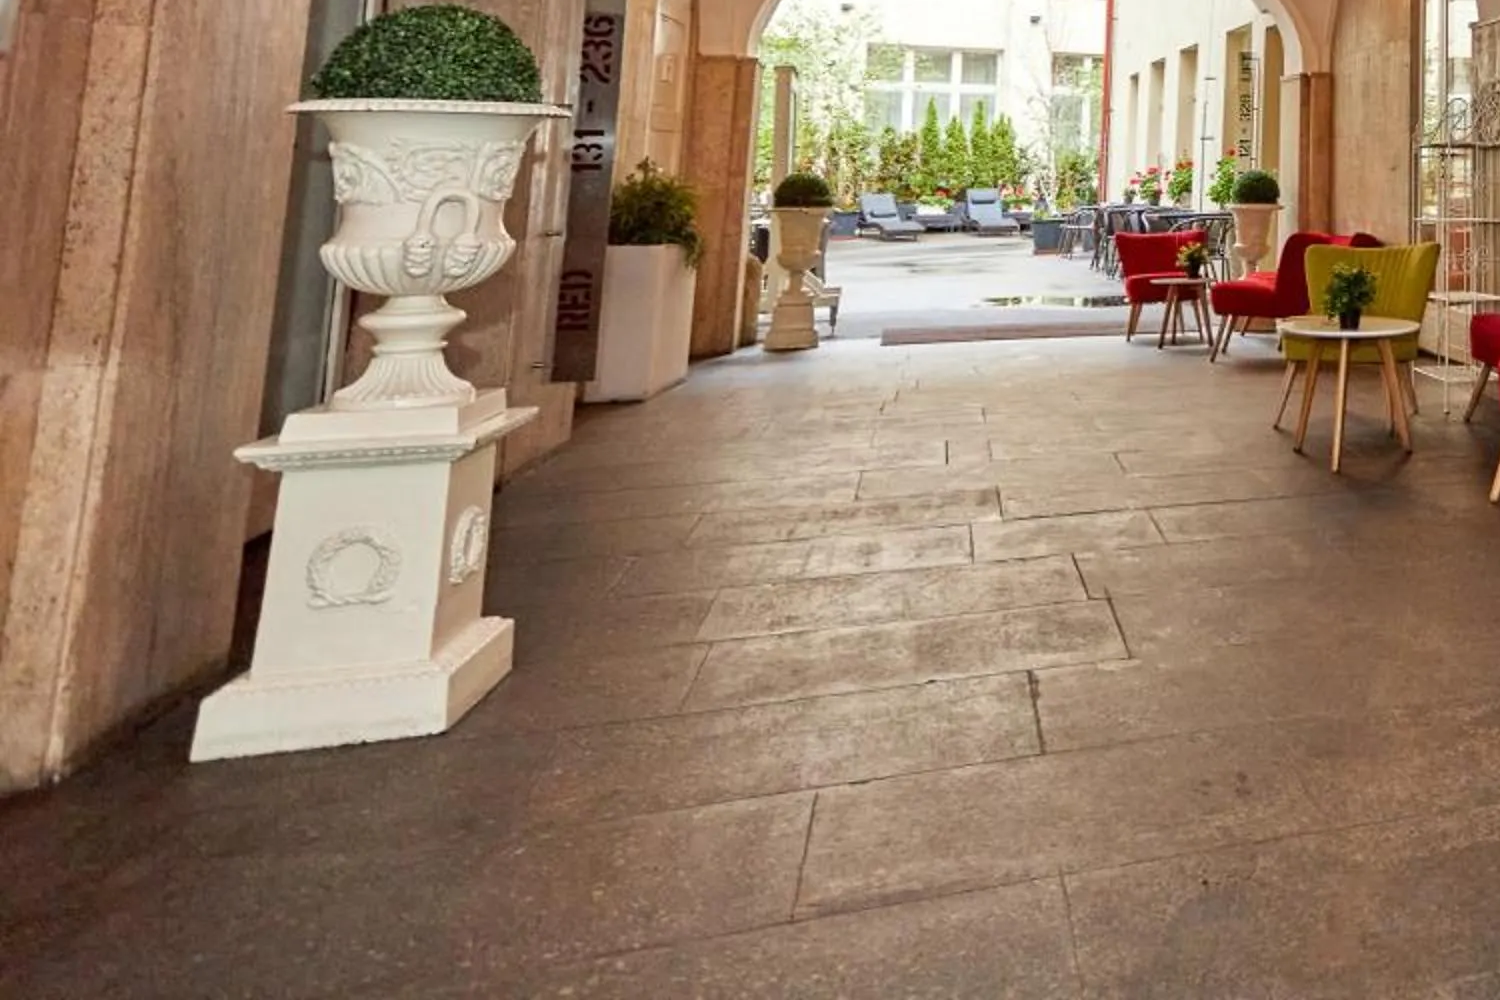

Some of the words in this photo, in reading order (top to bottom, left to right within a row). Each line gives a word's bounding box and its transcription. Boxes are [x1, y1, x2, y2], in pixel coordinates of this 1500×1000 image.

[580, 16, 614, 84] 236
[571, 129, 605, 171] 131
[556, 269, 593, 332] RED
